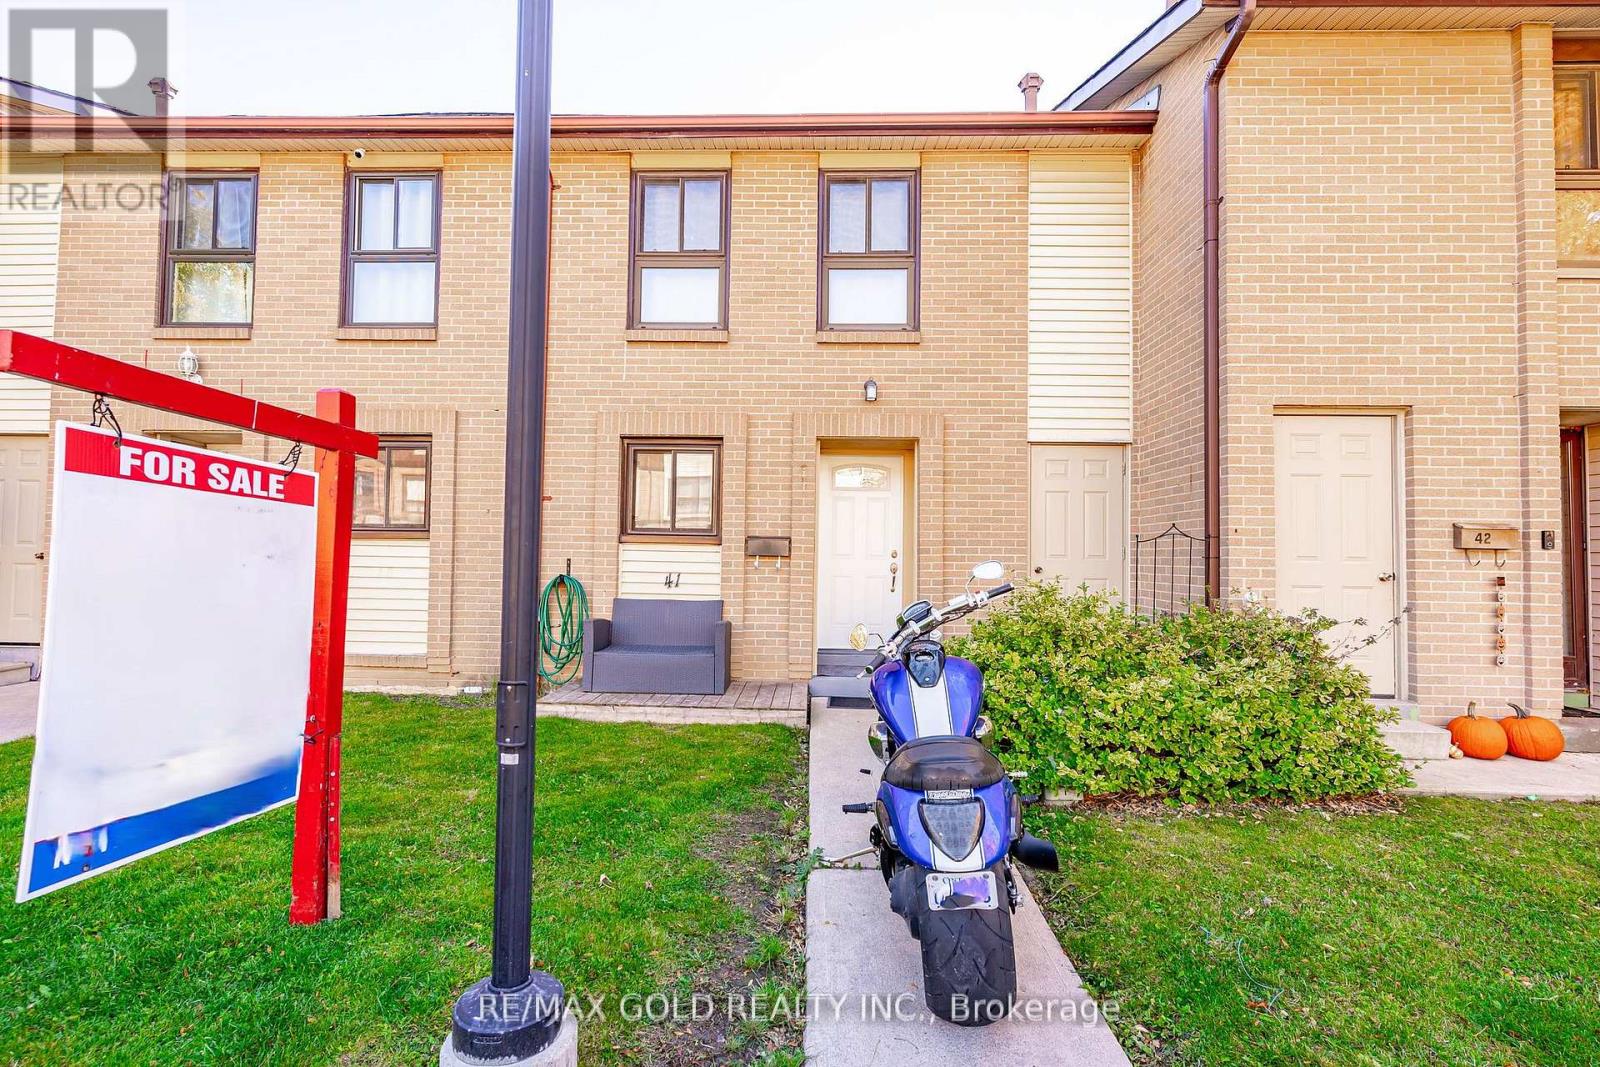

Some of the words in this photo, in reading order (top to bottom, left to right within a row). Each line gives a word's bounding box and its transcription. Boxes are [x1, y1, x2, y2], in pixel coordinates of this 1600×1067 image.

[119, 445, 196, 486] FOR
[207, 463, 285, 500] SALE
[1474, 532, 1491, 544] 42
[664, 572, 681, 588] 41
